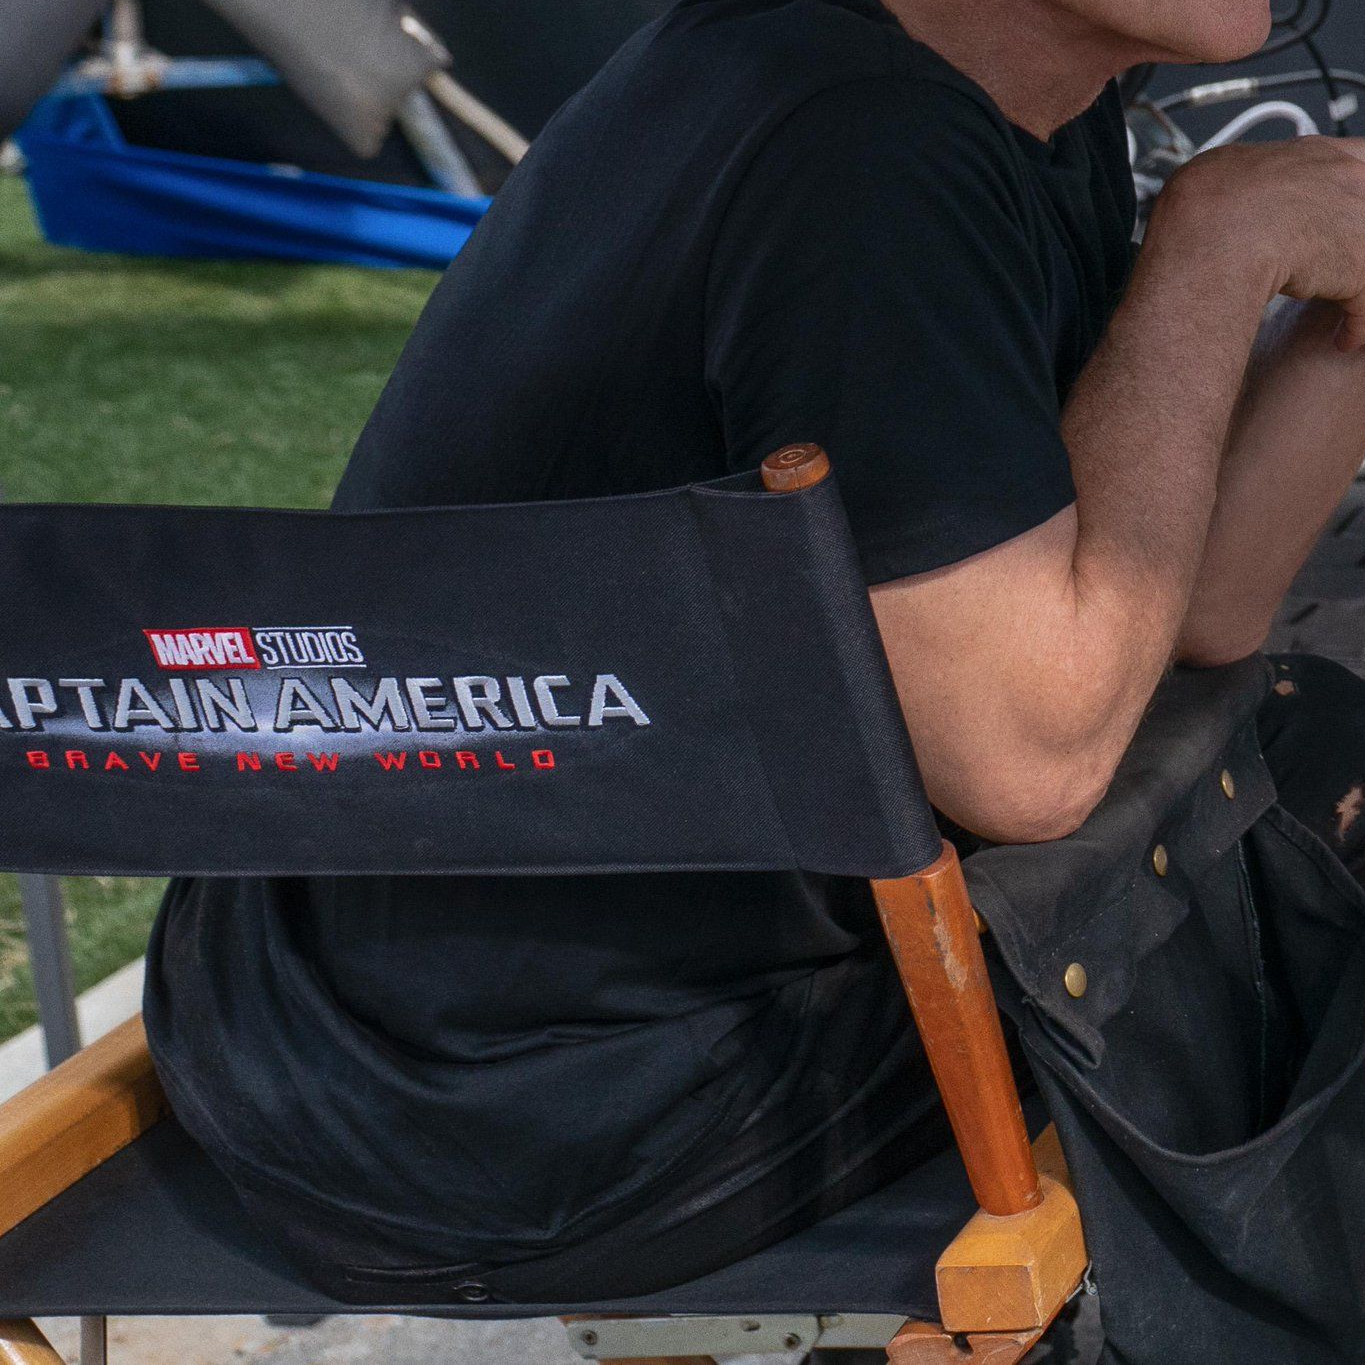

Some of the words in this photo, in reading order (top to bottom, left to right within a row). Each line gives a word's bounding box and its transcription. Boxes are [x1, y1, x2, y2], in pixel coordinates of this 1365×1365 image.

[150, 631, 256, 667] MARVEL
[256, 629, 366, 666] STUDIOS
[0, 677, 257, 729] PTAIN
[276, 674, 651, 730] AMERICA
[26, 749, 200, 772] BRAVE
[236, 751, 339, 772] NEW
[374, 749, 556, 771] WORLD
